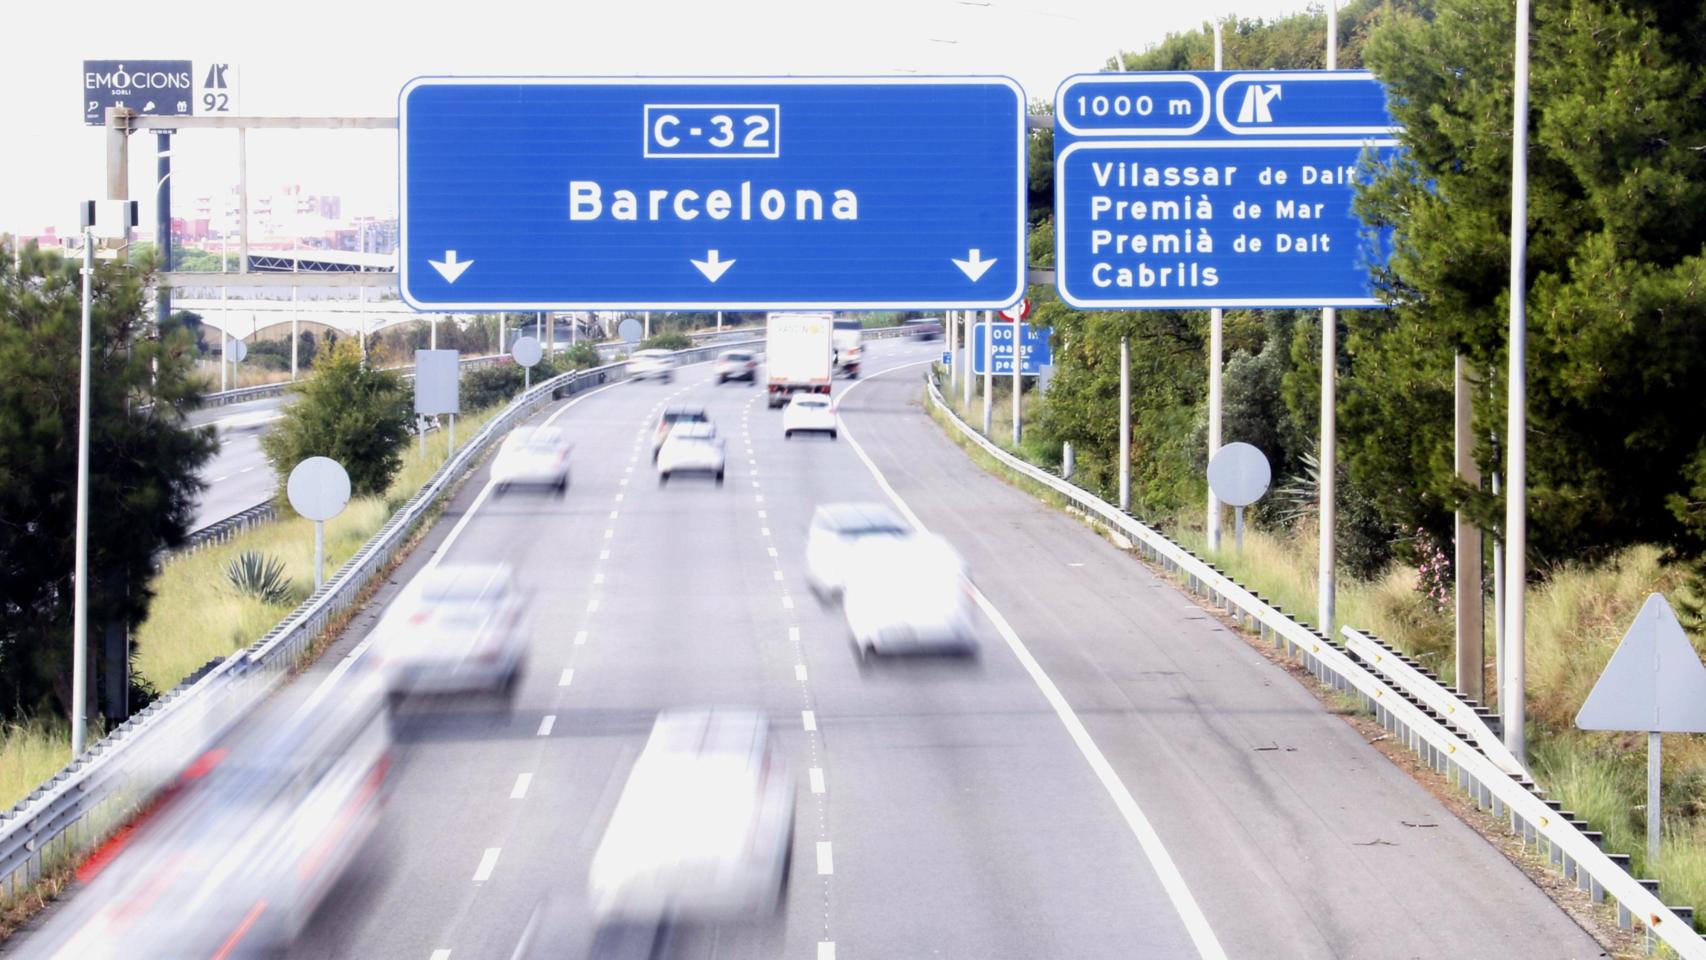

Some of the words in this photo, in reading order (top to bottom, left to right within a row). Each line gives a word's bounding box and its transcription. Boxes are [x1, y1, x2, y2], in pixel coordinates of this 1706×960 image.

[203, 93, 229, 112] 92
[1077, 95, 1153, 117] 1000
[1168, 99, 1192, 116] m
[654, 114, 770, 148] C-32
[1091, 162, 1237, 187] Vilassar
[1258, 166, 1288, 185] de
[1302, 165, 1356, 185] Dalt
[569, 180, 858, 221] Barcelona
[1091, 194, 1213, 221] Premià
[1232, 200, 1262, 220] de
[1276, 199, 1325, 219] Mar
[1091, 227, 1213, 254] Premià
[1233, 233, 1262, 253] de
[1276, 233, 1330, 253] Dalt
[1091, 262, 1219, 288] Cabrils
[991, 345, 1034, 355] peage
